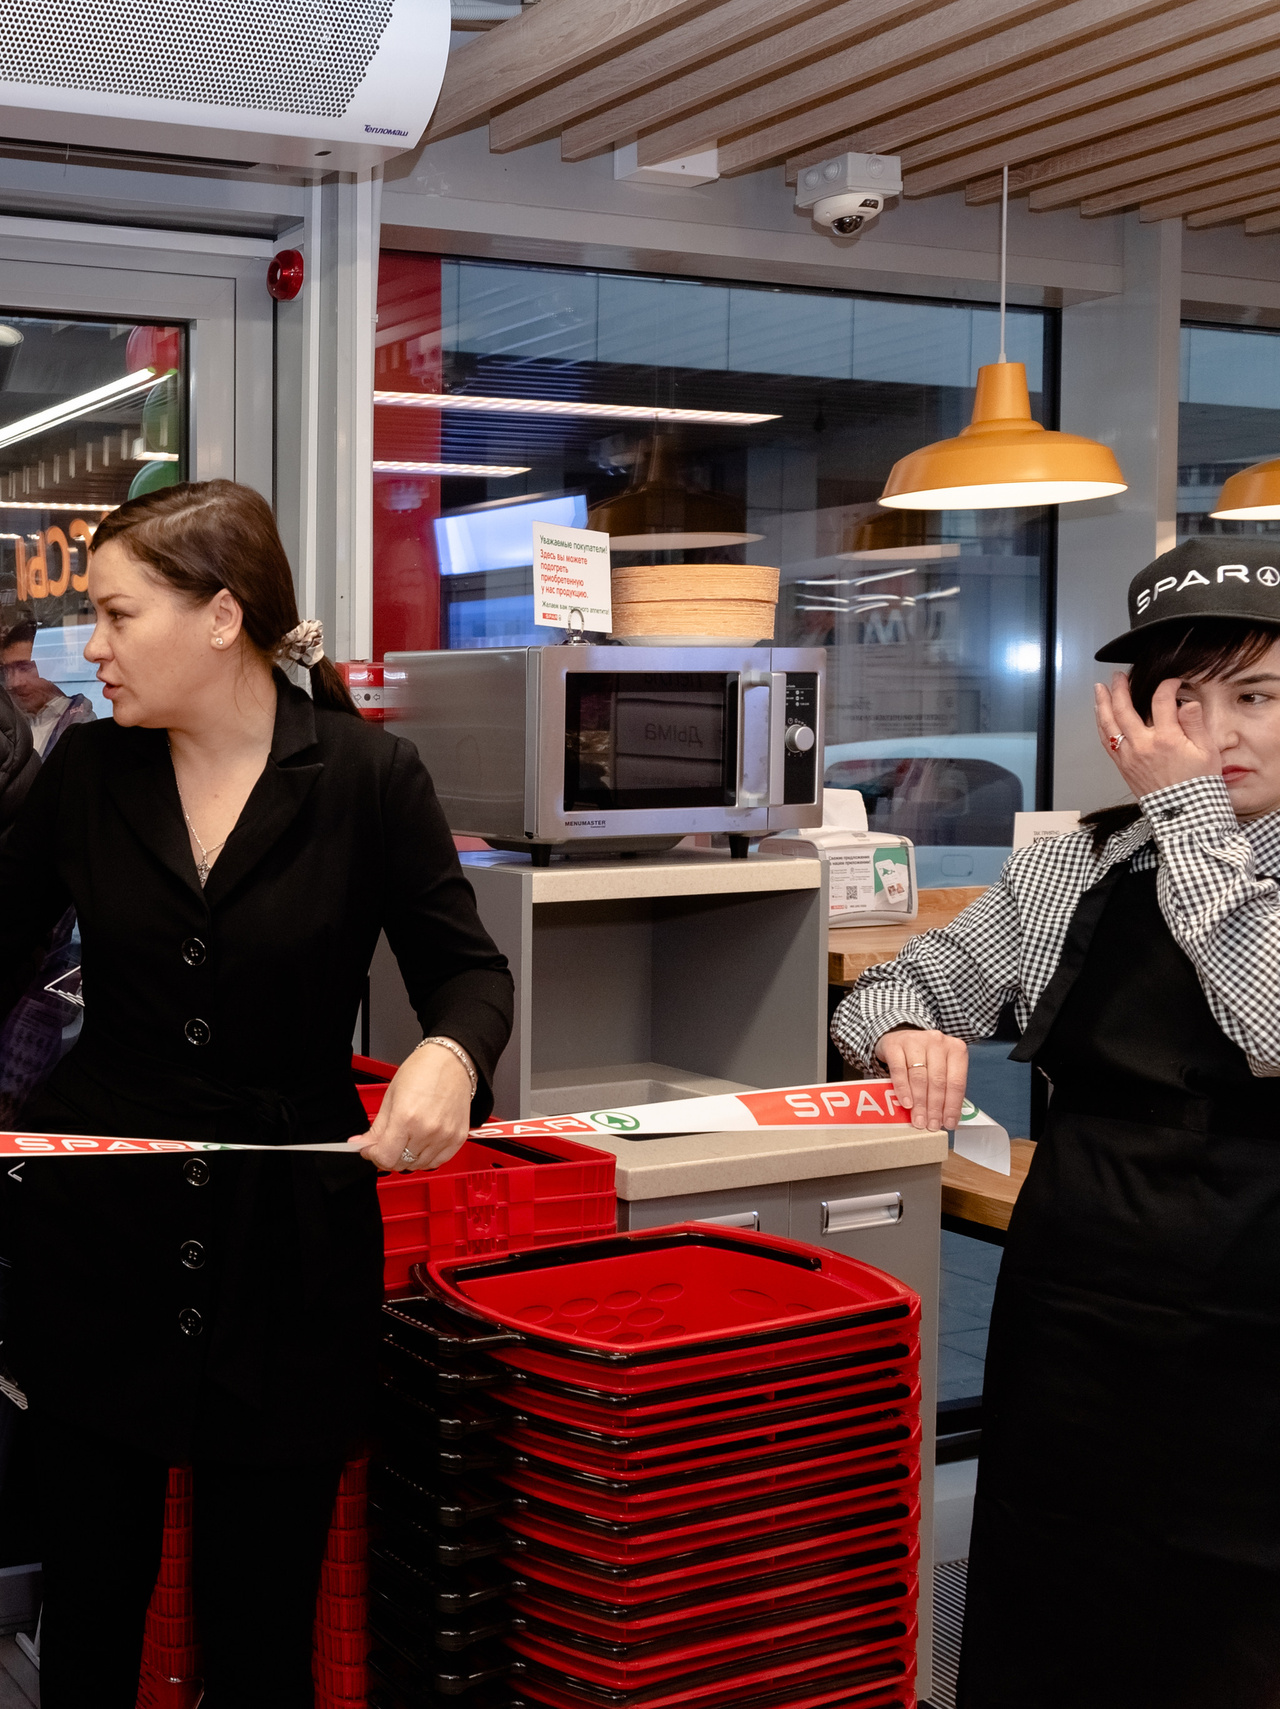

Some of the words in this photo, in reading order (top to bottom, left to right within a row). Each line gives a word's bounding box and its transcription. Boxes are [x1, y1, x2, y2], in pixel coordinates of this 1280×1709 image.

[364, 124, 409, 136] Тепломаш
[540, 534, 572, 548] Уважаемые
[574, 542, 608, 554] покупатели!
[540, 549, 556, 560] Здесь
[566, 556, 588, 564] можете
[540, 562, 568, 573] подогреть
[541, 574, 584, 588] приобретенную
[541, 586, 545, 594] у
[546, 586, 555, 594] нас
[556, 588, 588, 598] продукцию.
[1137, 564, 1250, 614] SPAR
